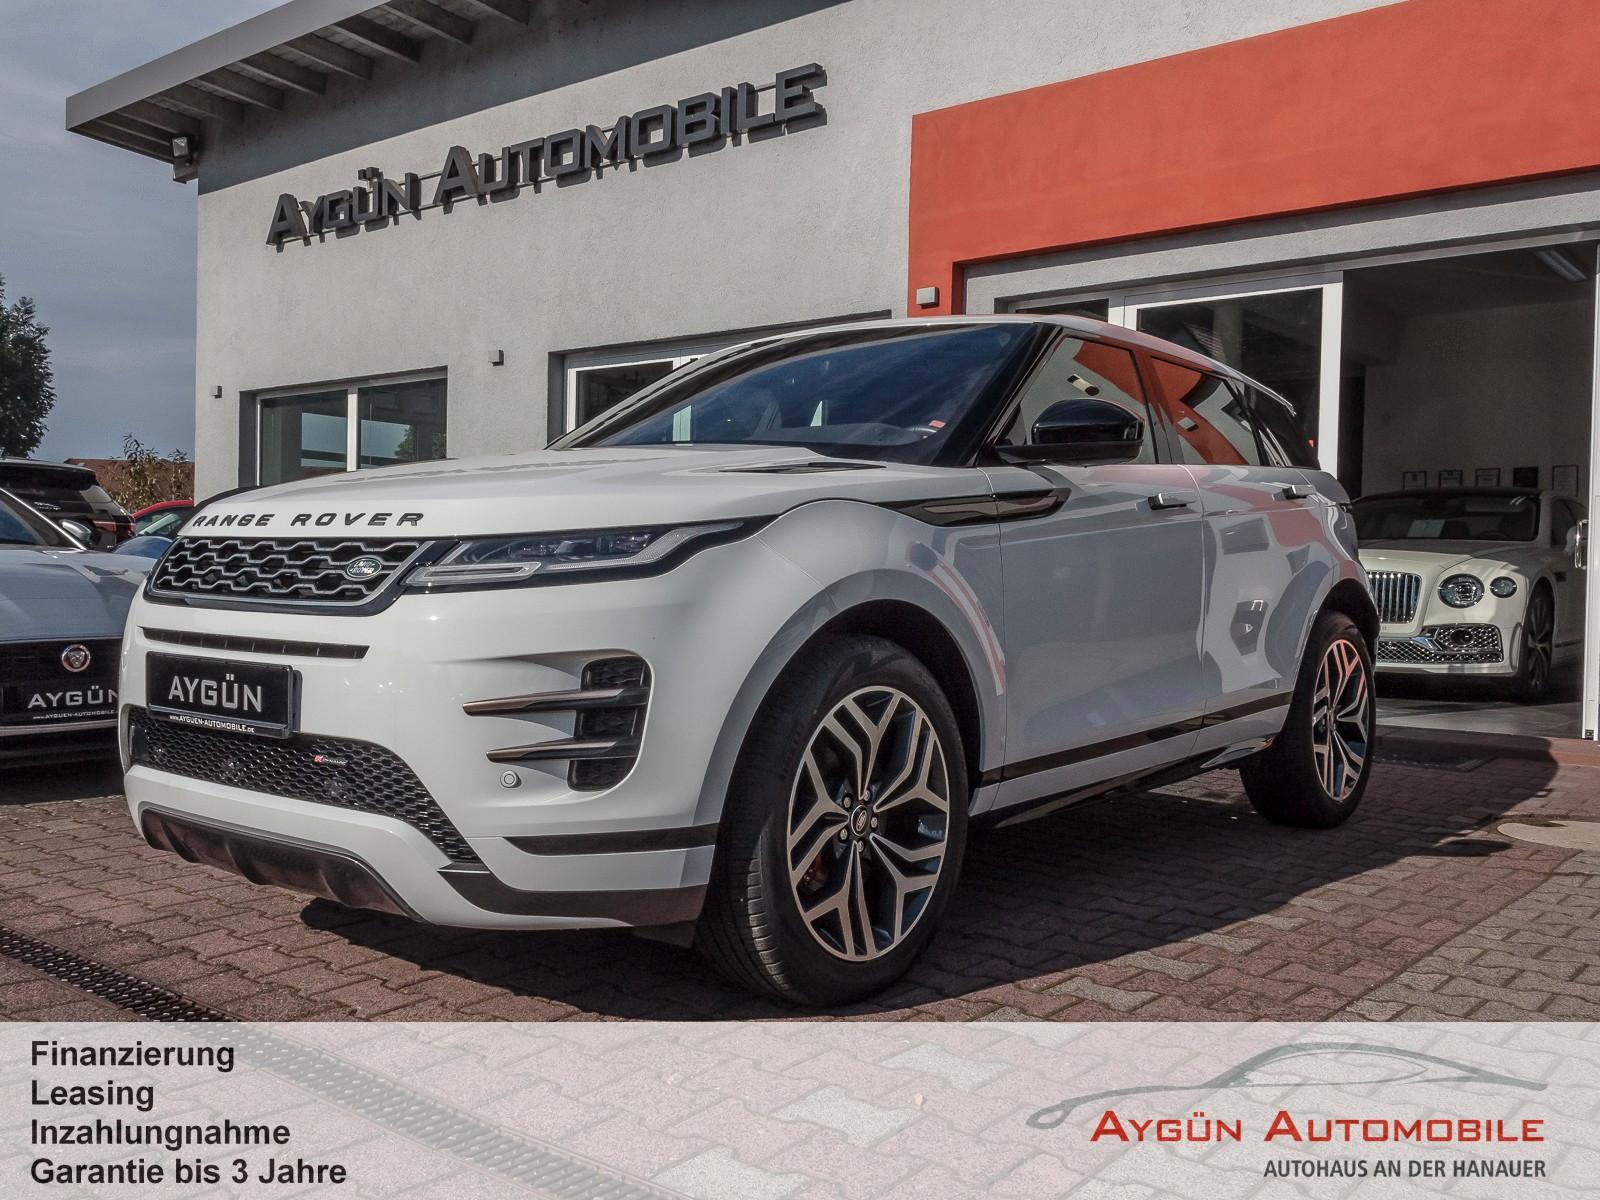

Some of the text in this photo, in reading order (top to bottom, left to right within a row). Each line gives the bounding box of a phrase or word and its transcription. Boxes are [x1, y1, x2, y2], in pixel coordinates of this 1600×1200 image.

[266, 62, 827, 247] AYGÜN AUTOMOBILE
[192, 512, 424, 527] RANGE ROVER
[167, 673, 263, 713] AYGÜN
